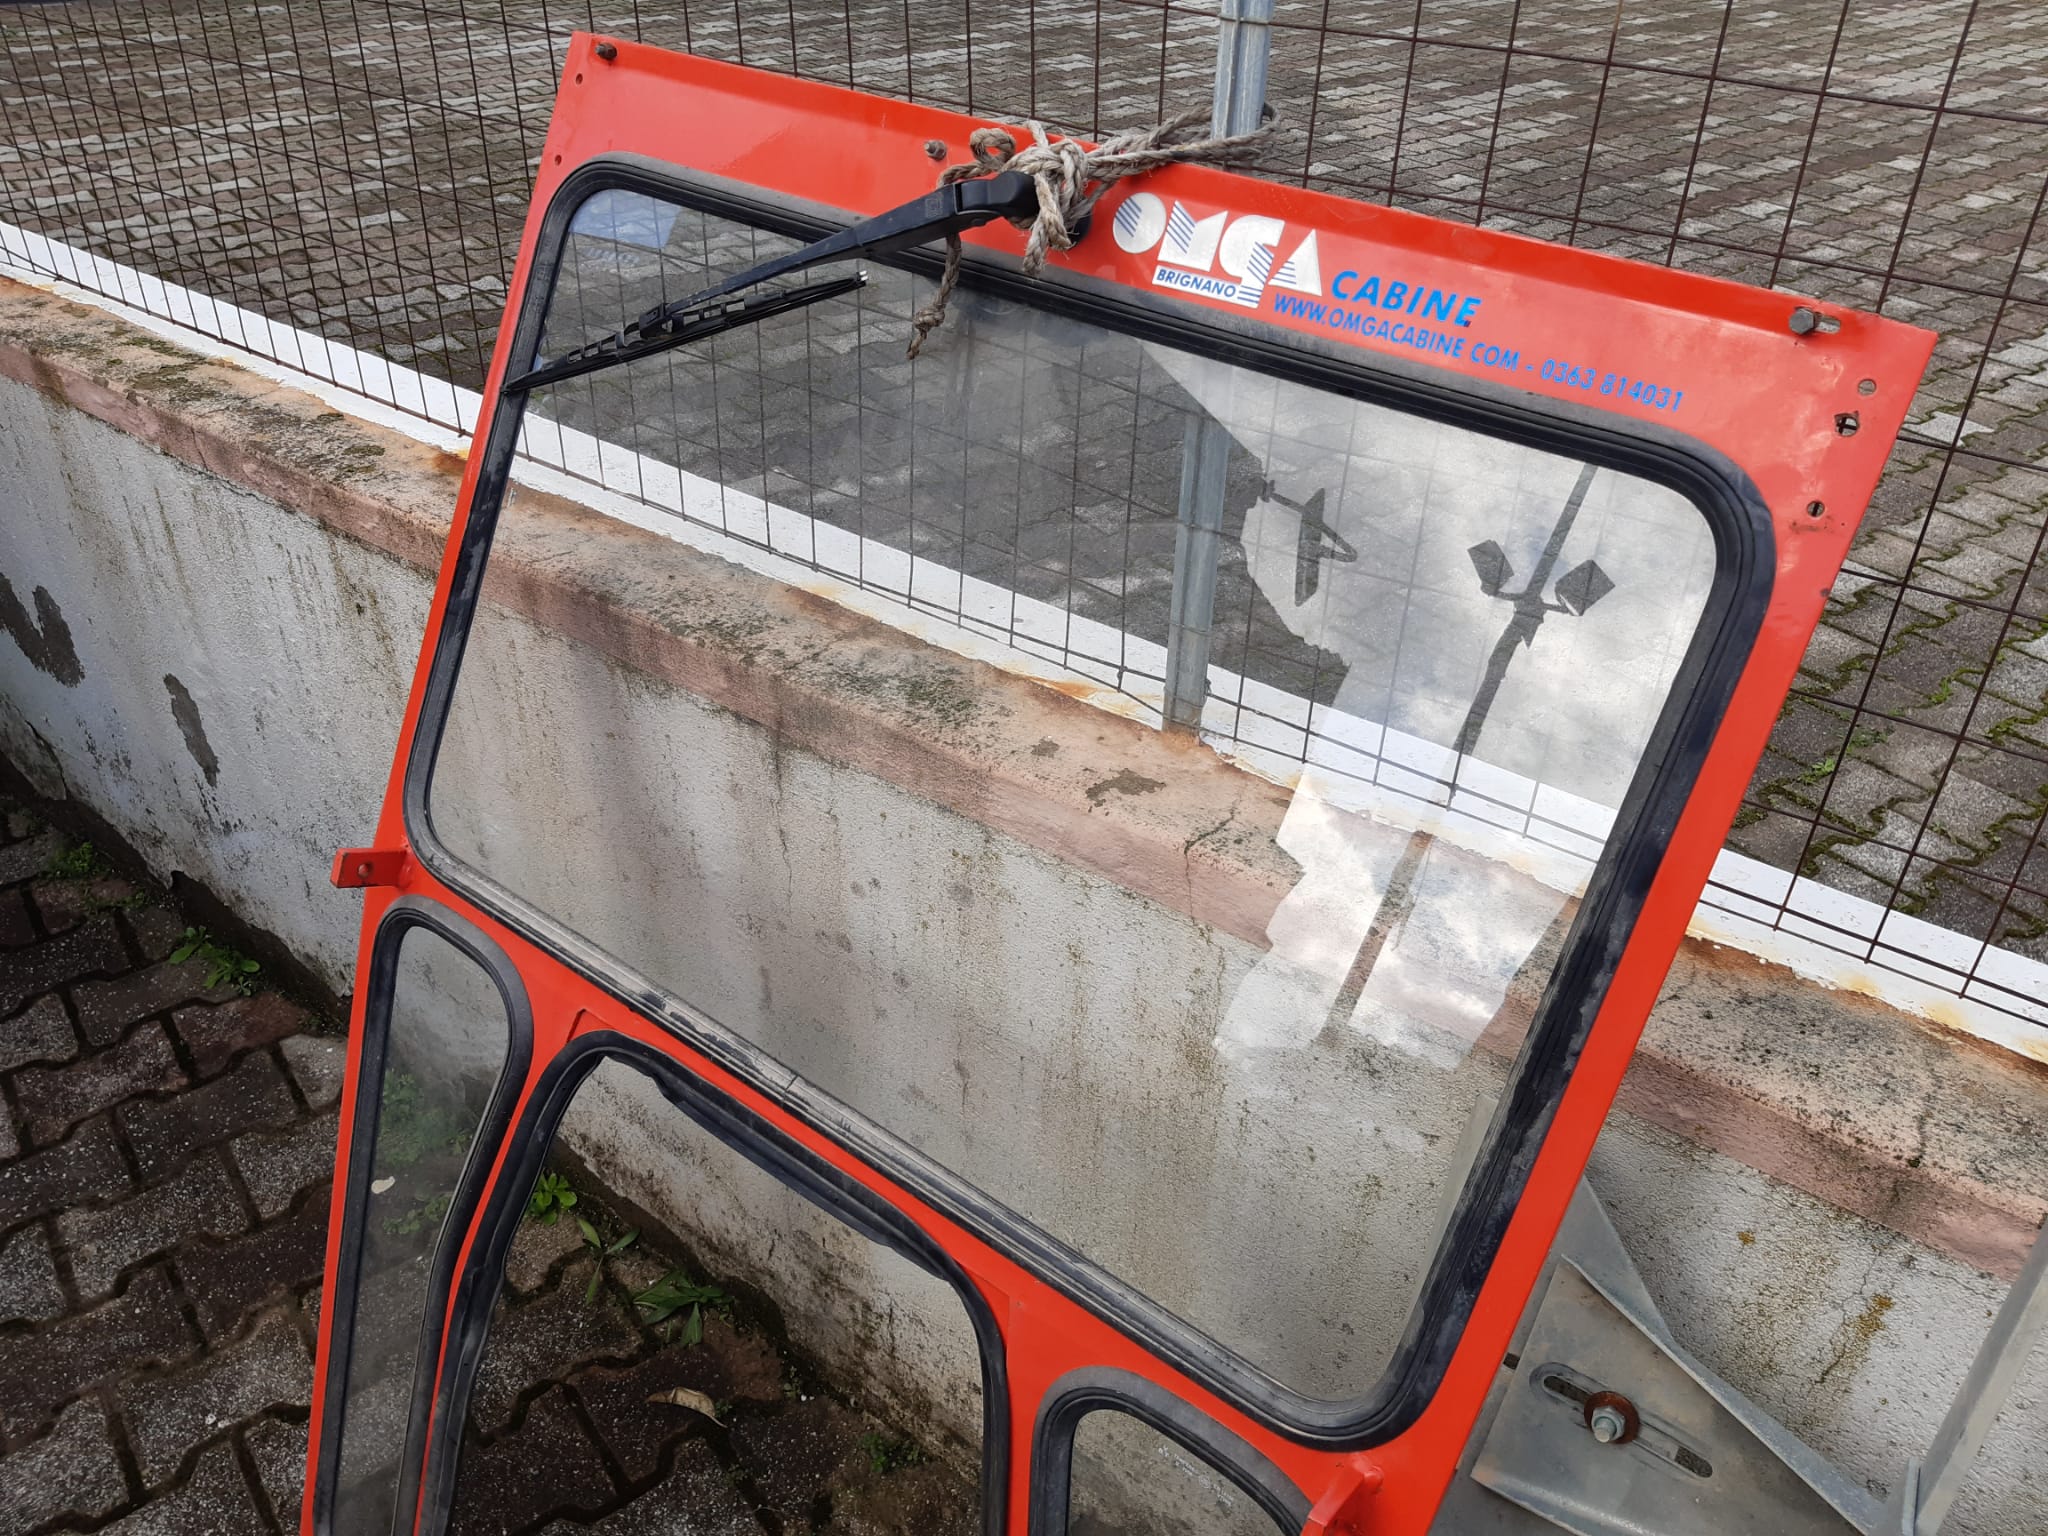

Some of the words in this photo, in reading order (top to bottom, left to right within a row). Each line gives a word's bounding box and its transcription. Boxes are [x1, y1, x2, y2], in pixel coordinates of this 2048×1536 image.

[1112, 192, 1323, 308] OMGA
[1156, 268, 1236, 298] BRIGNANO
[1331, 269, 1482, 328] CABINE
[1540, 357, 1597, 390] 0363
[1599, 373, 1684, 412] 814031
